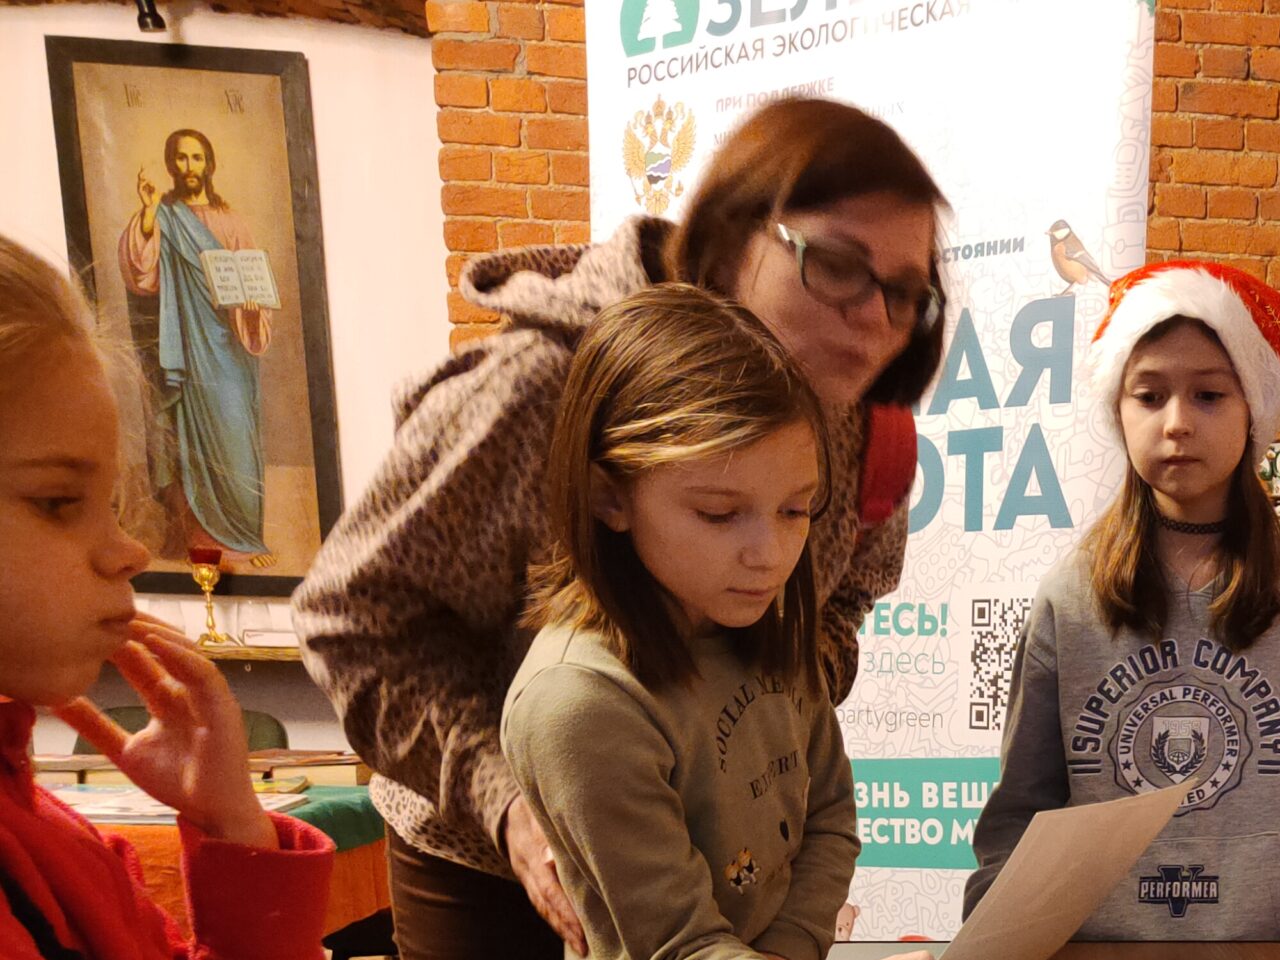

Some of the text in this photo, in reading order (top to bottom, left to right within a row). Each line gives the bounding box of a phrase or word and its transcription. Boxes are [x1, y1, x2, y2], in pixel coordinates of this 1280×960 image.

[627, 38, 765, 88] РОССИЙСКАЯ
[936, 237, 1024, 264] СТОЯНИИ
[909, 295, 1075, 416] АЯ
[863, 651, 946, 678] здесь
[1070, 638, 1180, 754] SUPERIOR
[1119, 687, 1238, 758] UNIVERSAL PERFORMER
[1140, 881, 1218, 899] PERFORMER
